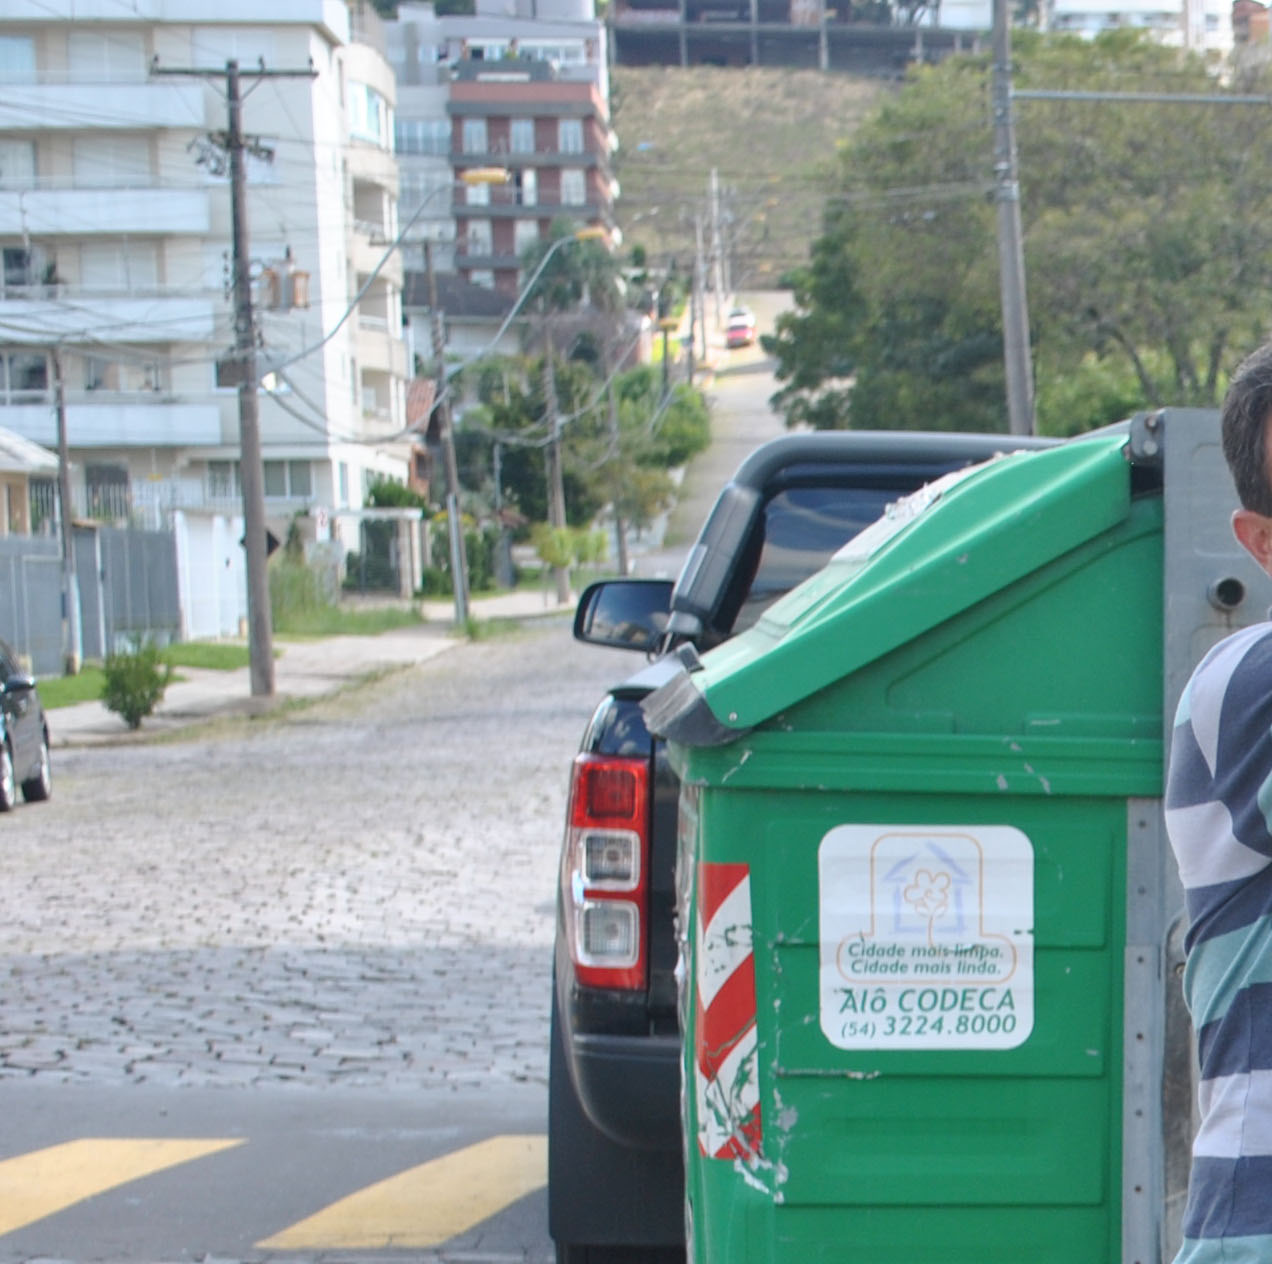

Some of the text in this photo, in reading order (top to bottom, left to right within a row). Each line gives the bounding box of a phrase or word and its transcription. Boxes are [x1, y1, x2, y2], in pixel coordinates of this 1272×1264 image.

[848, 943, 1004, 961] Cidade mais limpa.
[851, 959, 1002, 975] Cidade mais linda.
[839, 988, 1016, 1013] Alô CODECA
[841, 1014, 1017, 1039] (54) 3224.8000
